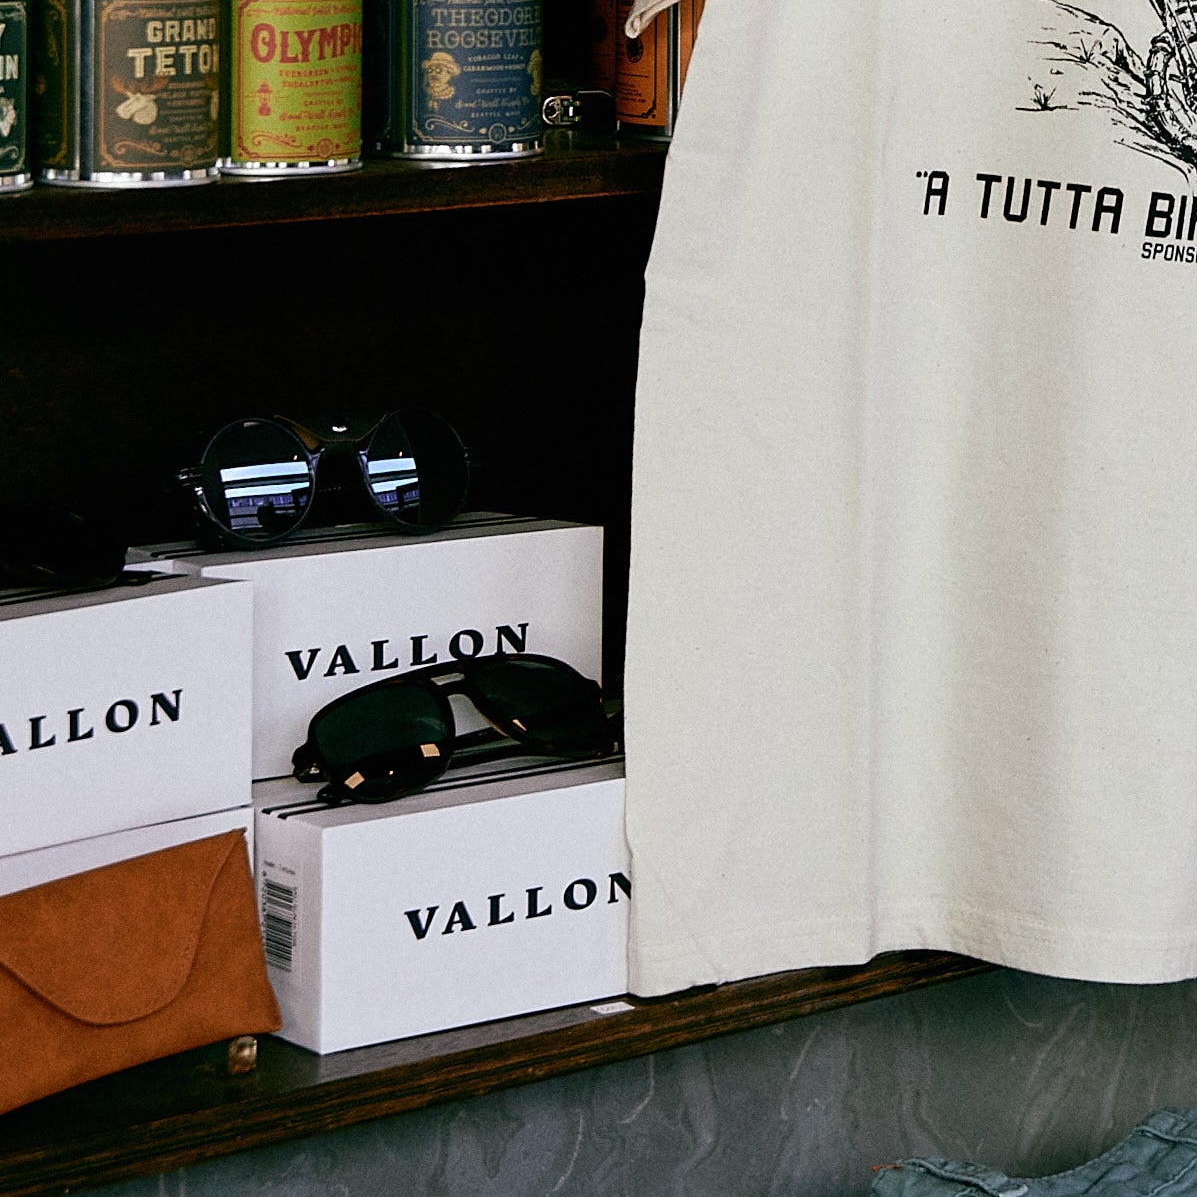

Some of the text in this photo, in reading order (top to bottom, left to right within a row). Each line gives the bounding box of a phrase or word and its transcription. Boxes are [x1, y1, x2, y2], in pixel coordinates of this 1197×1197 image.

[146, 18, 216, 44] GRAND
[976, 173, 1125, 235] TUTTA
[284, 622, 530, 681] VALLON
[403, 872, 632, 940] VALLON
